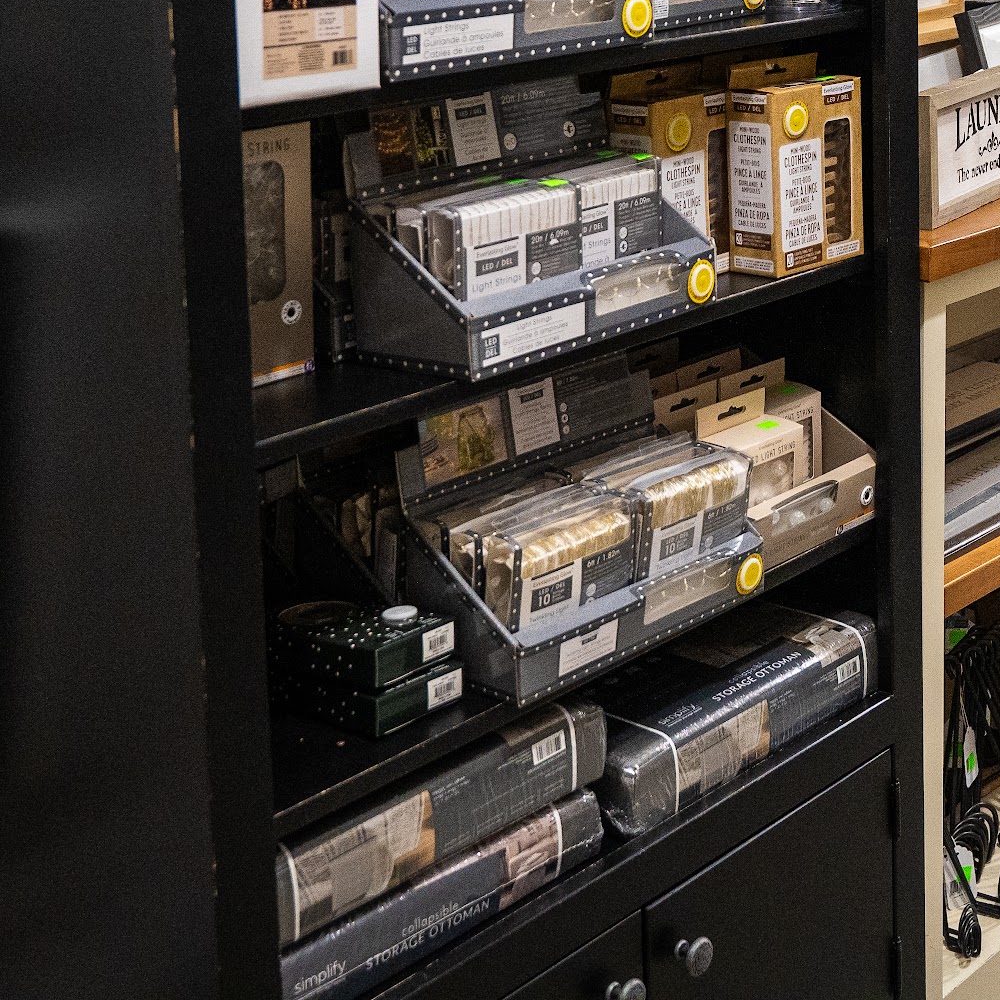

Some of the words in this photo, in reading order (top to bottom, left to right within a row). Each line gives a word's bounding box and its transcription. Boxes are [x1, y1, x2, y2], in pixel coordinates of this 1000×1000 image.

[424, 25, 443, 35] Light
[446, 22, 469, 33] Strings
[407, 36, 418, 44] LED
[424, 36, 460, 47] Guirlande
[470, 30, 504, 43] ampoules
[407, 45, 418, 53] DEL
[465, 44, 484, 53] luces
[733, 134, 767, 146] CLOTHESPIN
[247, 138, 291, 158] STRING
[784, 151, 817, 168] CLOTHESPIN
[666, 163, 701, 181] CLOTHESPIN
[788, 166, 800, 176] LIGHT
[800, 164, 812, 174] STRING
[957, 167, 969, 183] The
[971, 162, 988, 178] never
[785, 188, 799, 200] PINCE
[804, 184, 818, 195] LINGE
[634, 197, 651, 206] 6.09m
[756, 210, 770, 221] ROPA
[594, 222, 604, 230] DEL
[785, 227, 799, 240] PINZA
[807, 222, 821, 234] ROPA
[531, 235, 543, 244] 20ft
[589, 238, 611, 249] Strings
[477, 247, 503, 258] Everlasting
[482, 263, 494, 271] LED
[501, 258, 513, 266] DEL
[472, 281, 493, 294] Light
[495, 274, 522, 287] Strings
[517, 321, 532, 331] Light
[532, 315, 552, 326] Strings
[539, 321, 568, 334] ampoules
[484, 337, 498, 346] LED
[544, 335, 560, 344] luces
[485, 349, 498, 358] DEL
[797, 406, 814, 418] STRING
[760, 448, 776, 463] LIGHT
[778, 441, 796, 456] STRING
[665, 543, 675, 554] 10
[538, 594, 551, 607] 10
[712, 675, 757, 702] STORAGE
[754, 651, 802, 678] OTTOMAN
[402, 900, 459, 936] collapsible
[366, 934, 425, 971] STORAGE
[429, 899, 490, 938] OTTOMAN
[294, 959, 347, 996] simplify
